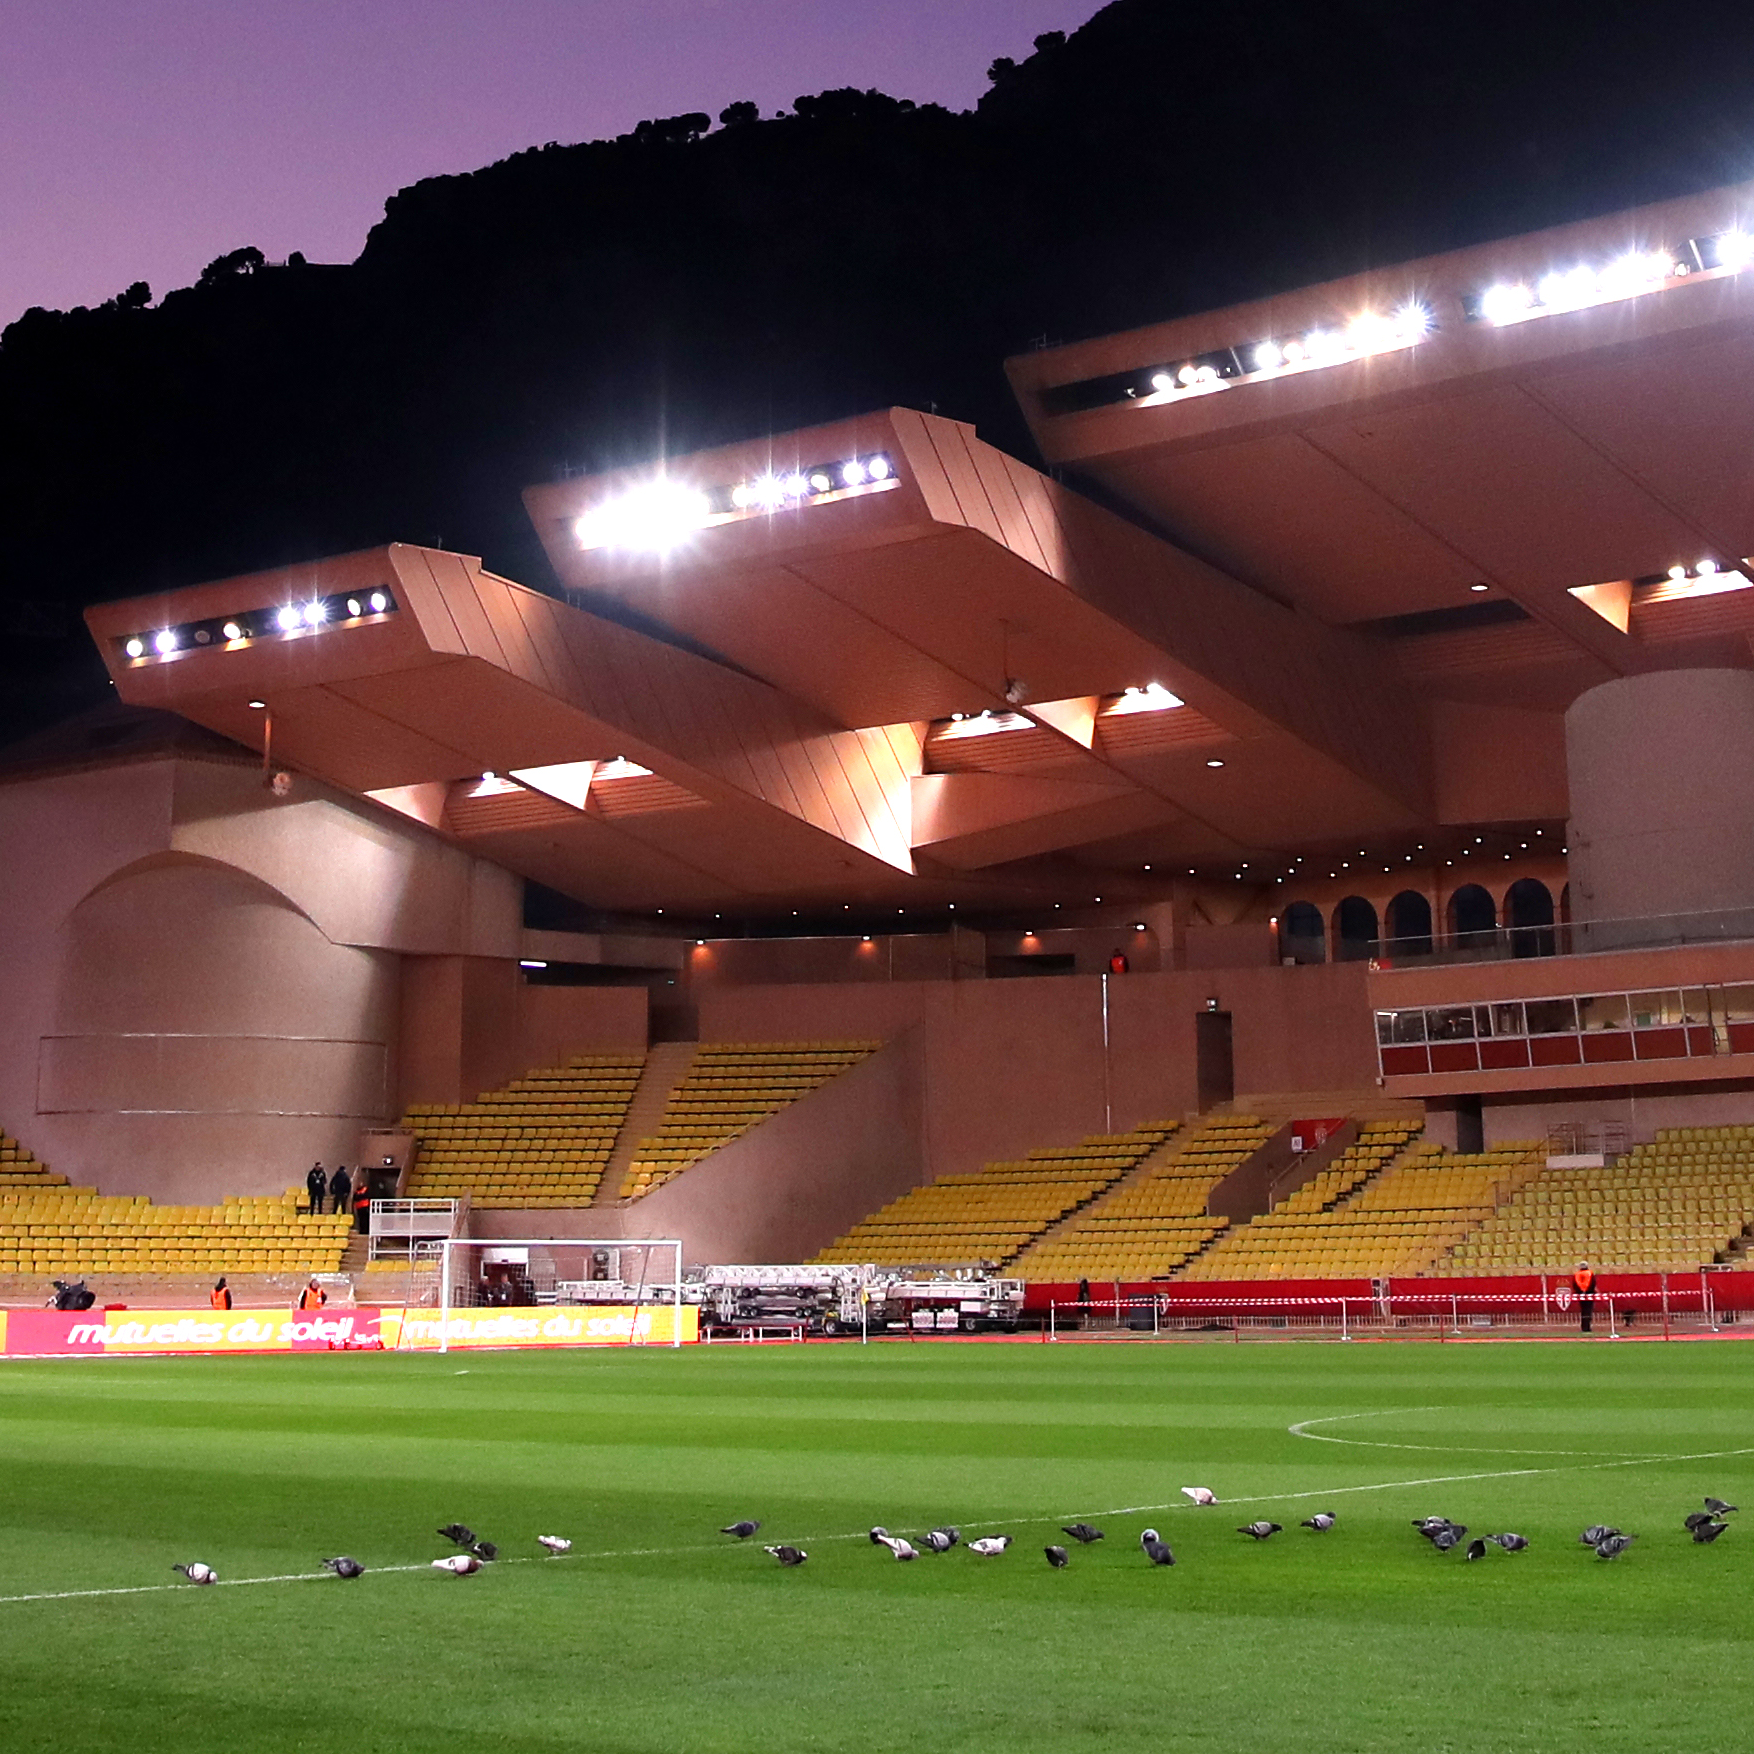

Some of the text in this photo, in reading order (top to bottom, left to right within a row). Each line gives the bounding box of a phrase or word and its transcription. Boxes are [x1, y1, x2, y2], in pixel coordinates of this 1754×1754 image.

[67, 1317, 355, 1344] mutuelles du soleil
[543, 1314, 582, 1337] du
